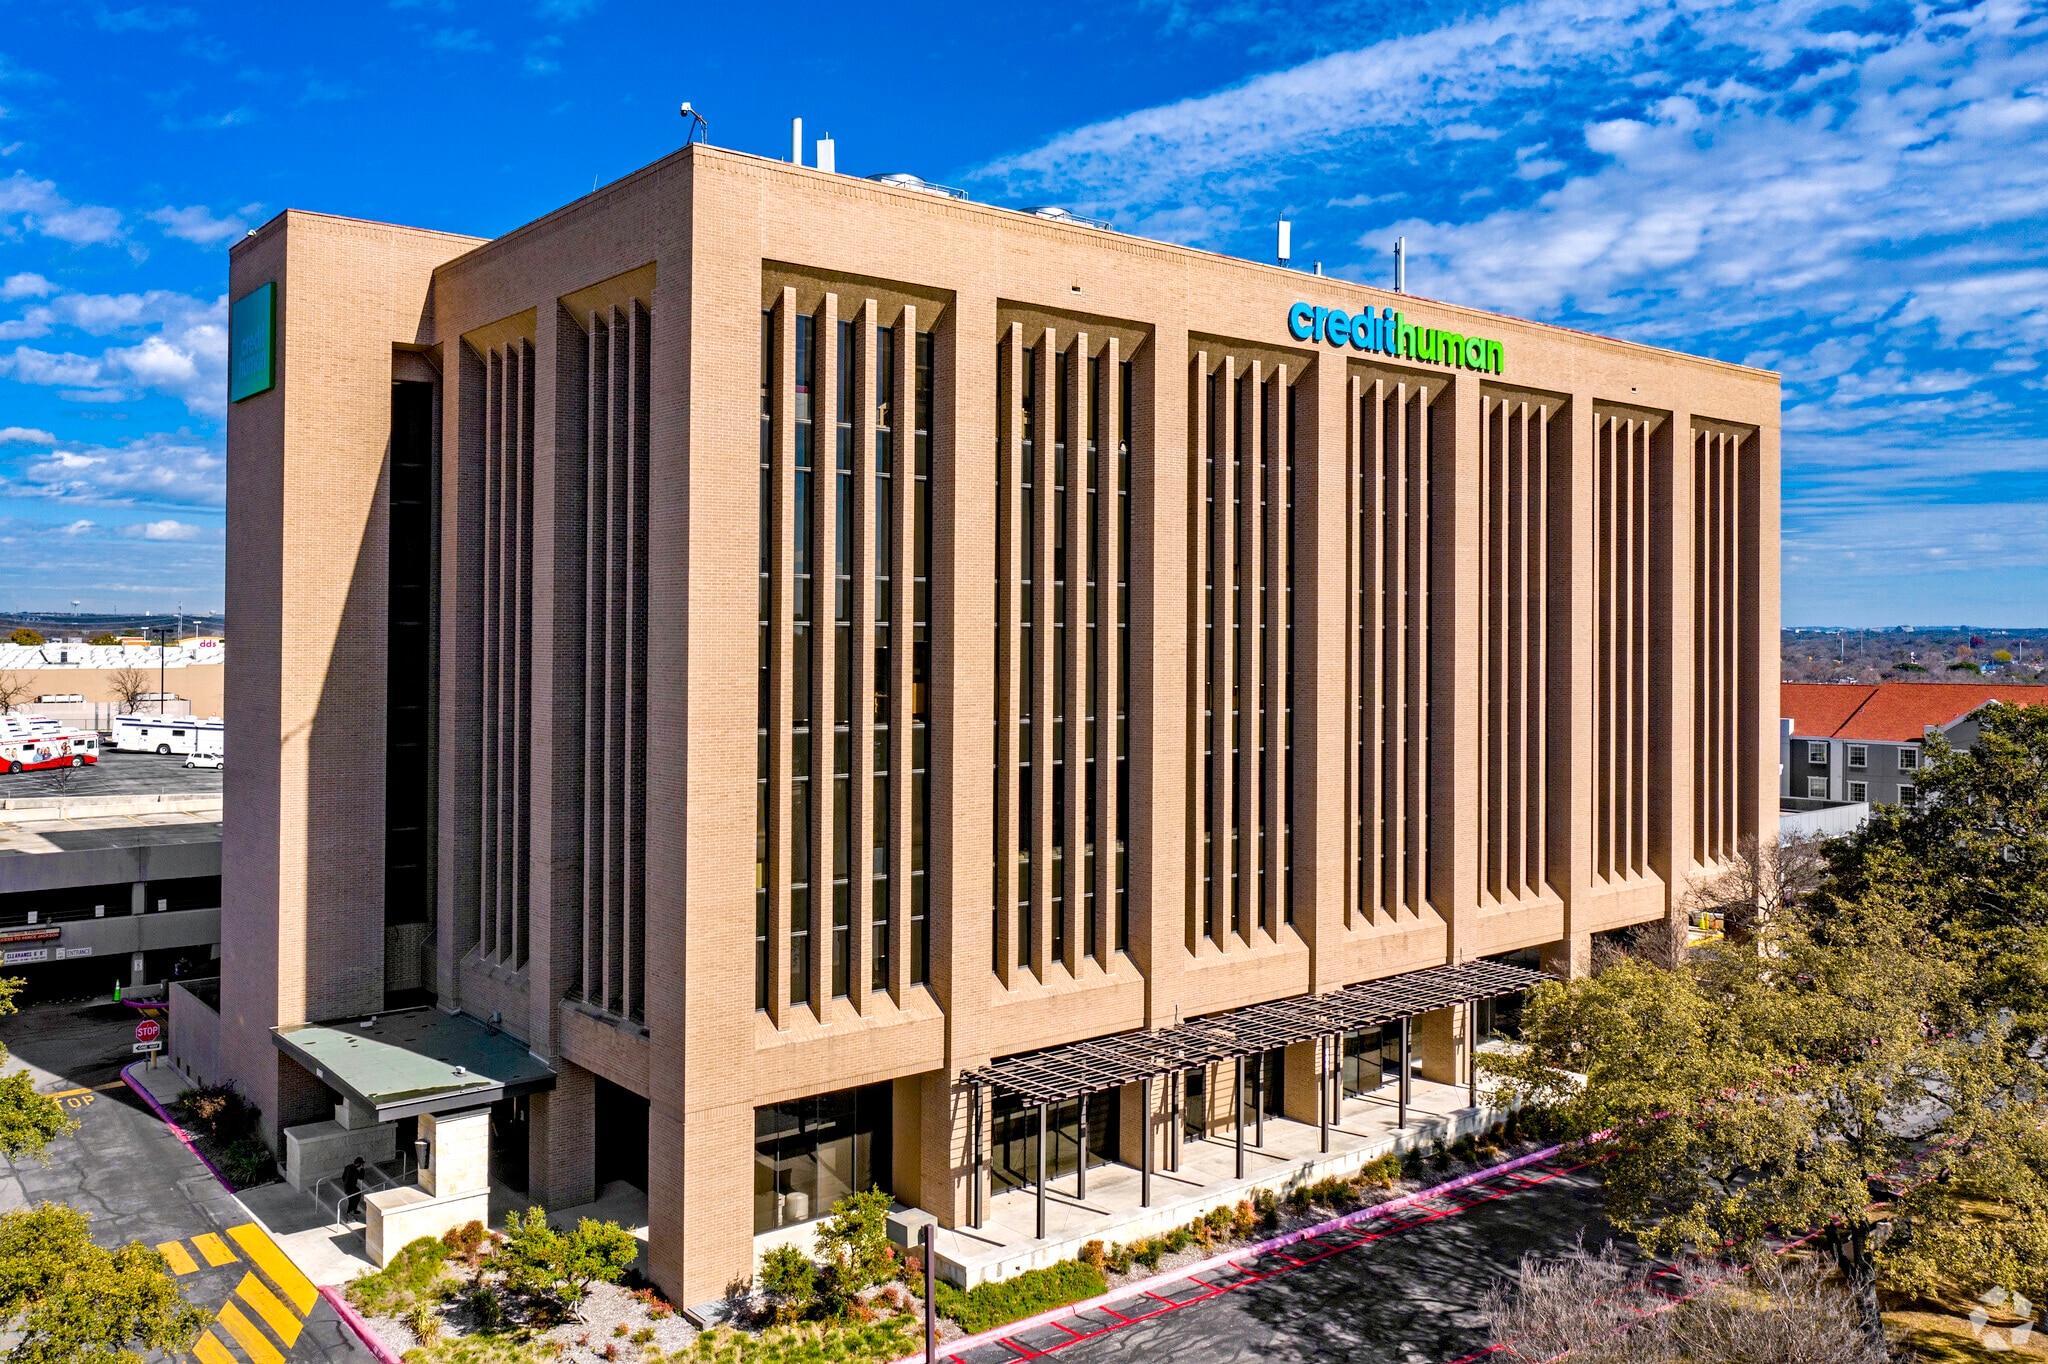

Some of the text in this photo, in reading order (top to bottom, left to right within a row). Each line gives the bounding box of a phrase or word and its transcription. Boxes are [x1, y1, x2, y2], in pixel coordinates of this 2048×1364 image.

[241, 322, 265, 356] credit
[1288, 302, 1505, 374] credithuman
[239, 350, 266, 379] human
[137, 1026, 158, 1037] STOP
[52, 1095, 95, 1111] TOP
